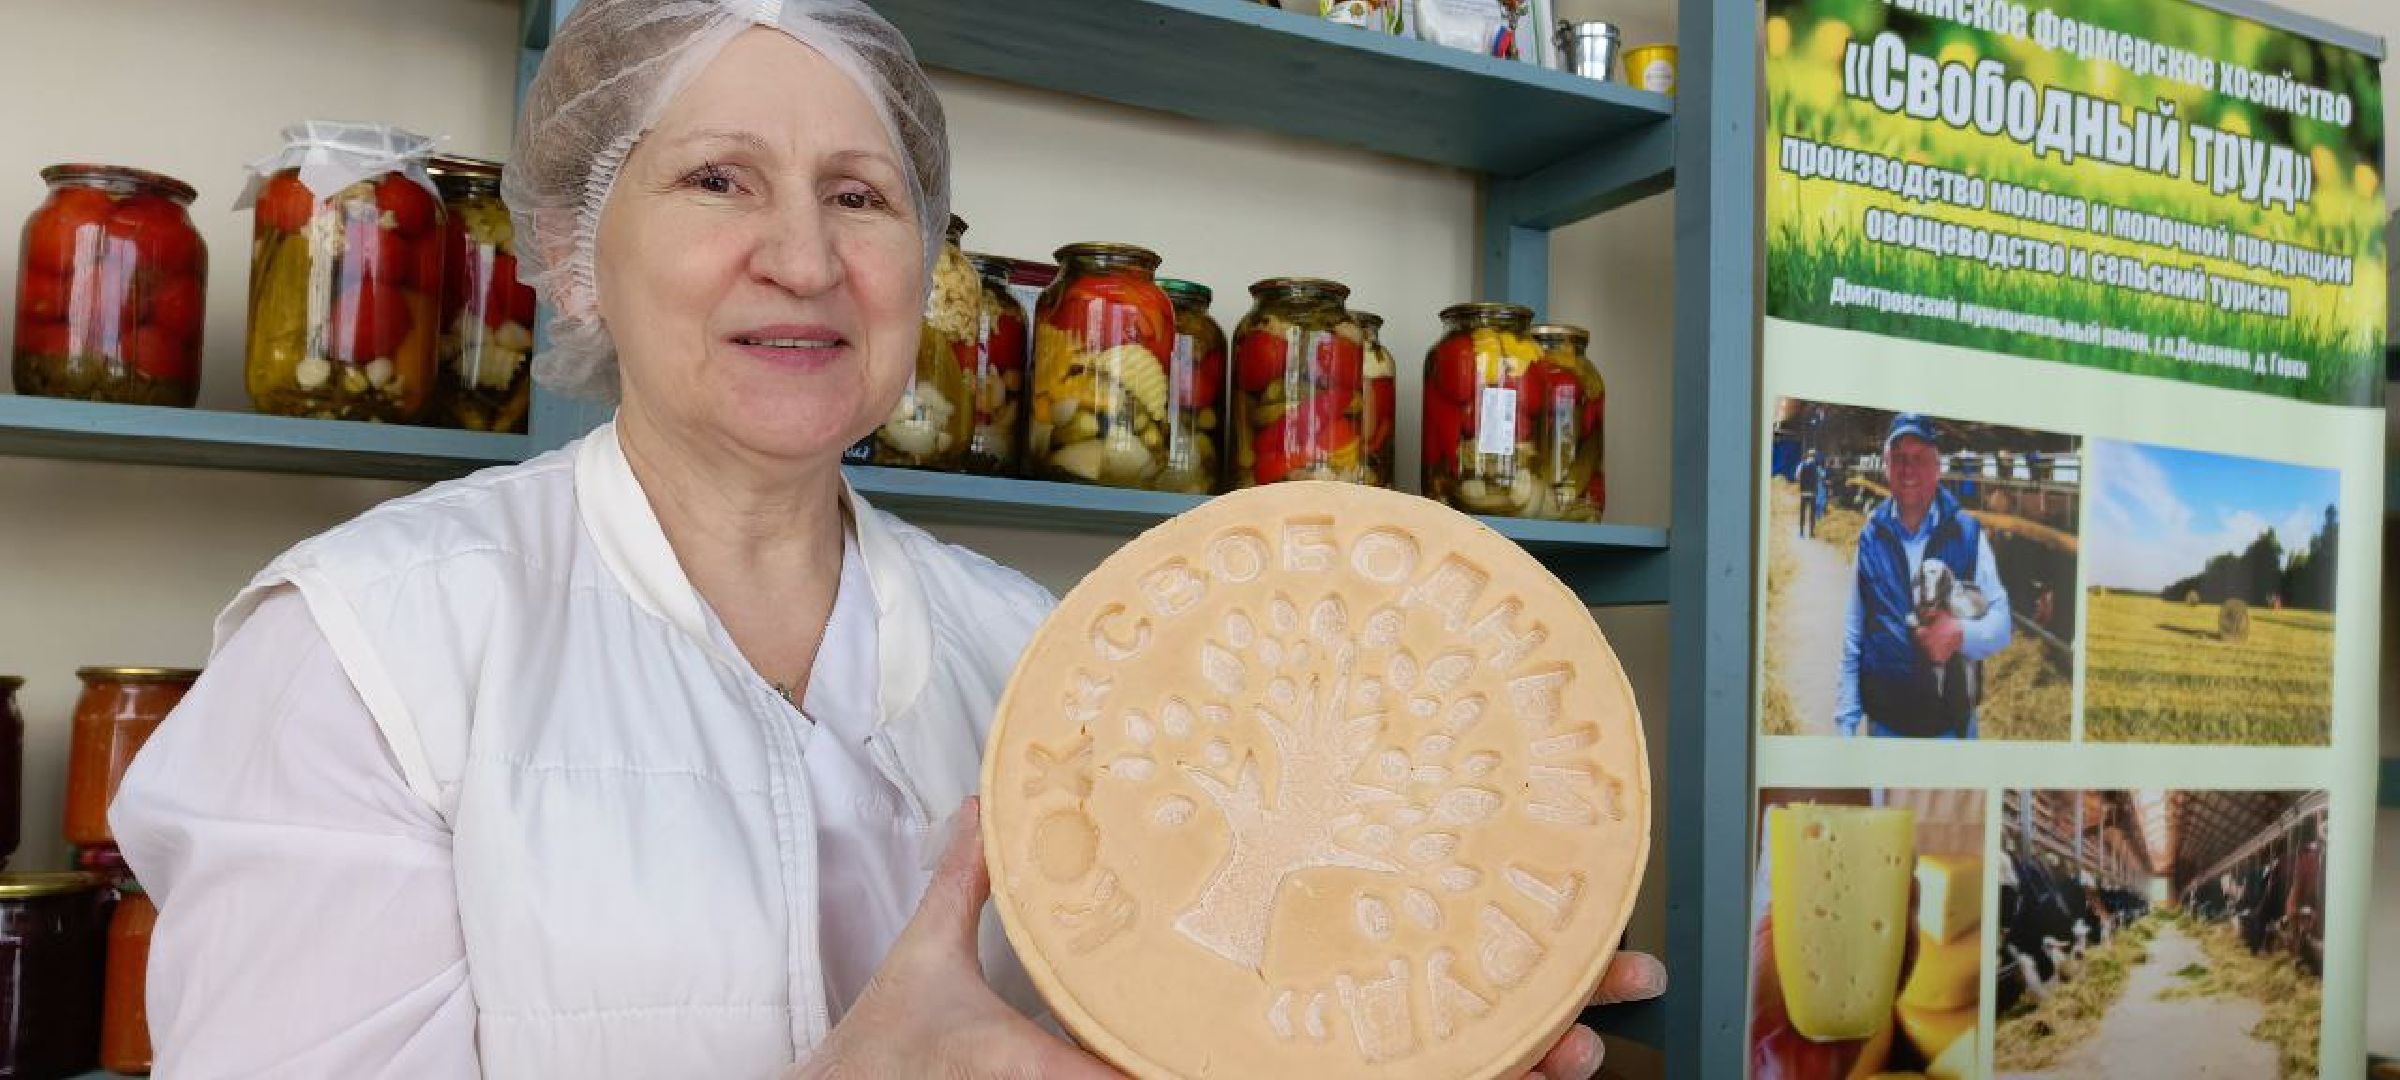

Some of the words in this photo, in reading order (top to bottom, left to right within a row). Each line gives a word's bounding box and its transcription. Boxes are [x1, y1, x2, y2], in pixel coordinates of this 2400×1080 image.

[1845, 32, 2180, 177] «Свободный
[2190, 125, 2312, 214] труд»
[2034, 8, 2214, 90] фермерское
[2220, 60, 2352, 127] хозяйство
[1781, 135, 1985, 210] производство
[1990, 180, 2088, 231] молока
[2091, 202, 2108, 236] и
[2112, 205, 2229, 260] молочной
[2233, 231, 2352, 286] продукции
[1866, 206, 2067, 276] овощеводство
[2070, 246, 2088, 280] и
[2091, 251, 2206, 303] сельский
[2209, 273, 2290, 319] туризм
[1830, 277, 1957, 320] Дмитровский
[1960, 302, 2100, 344] муниципальный
